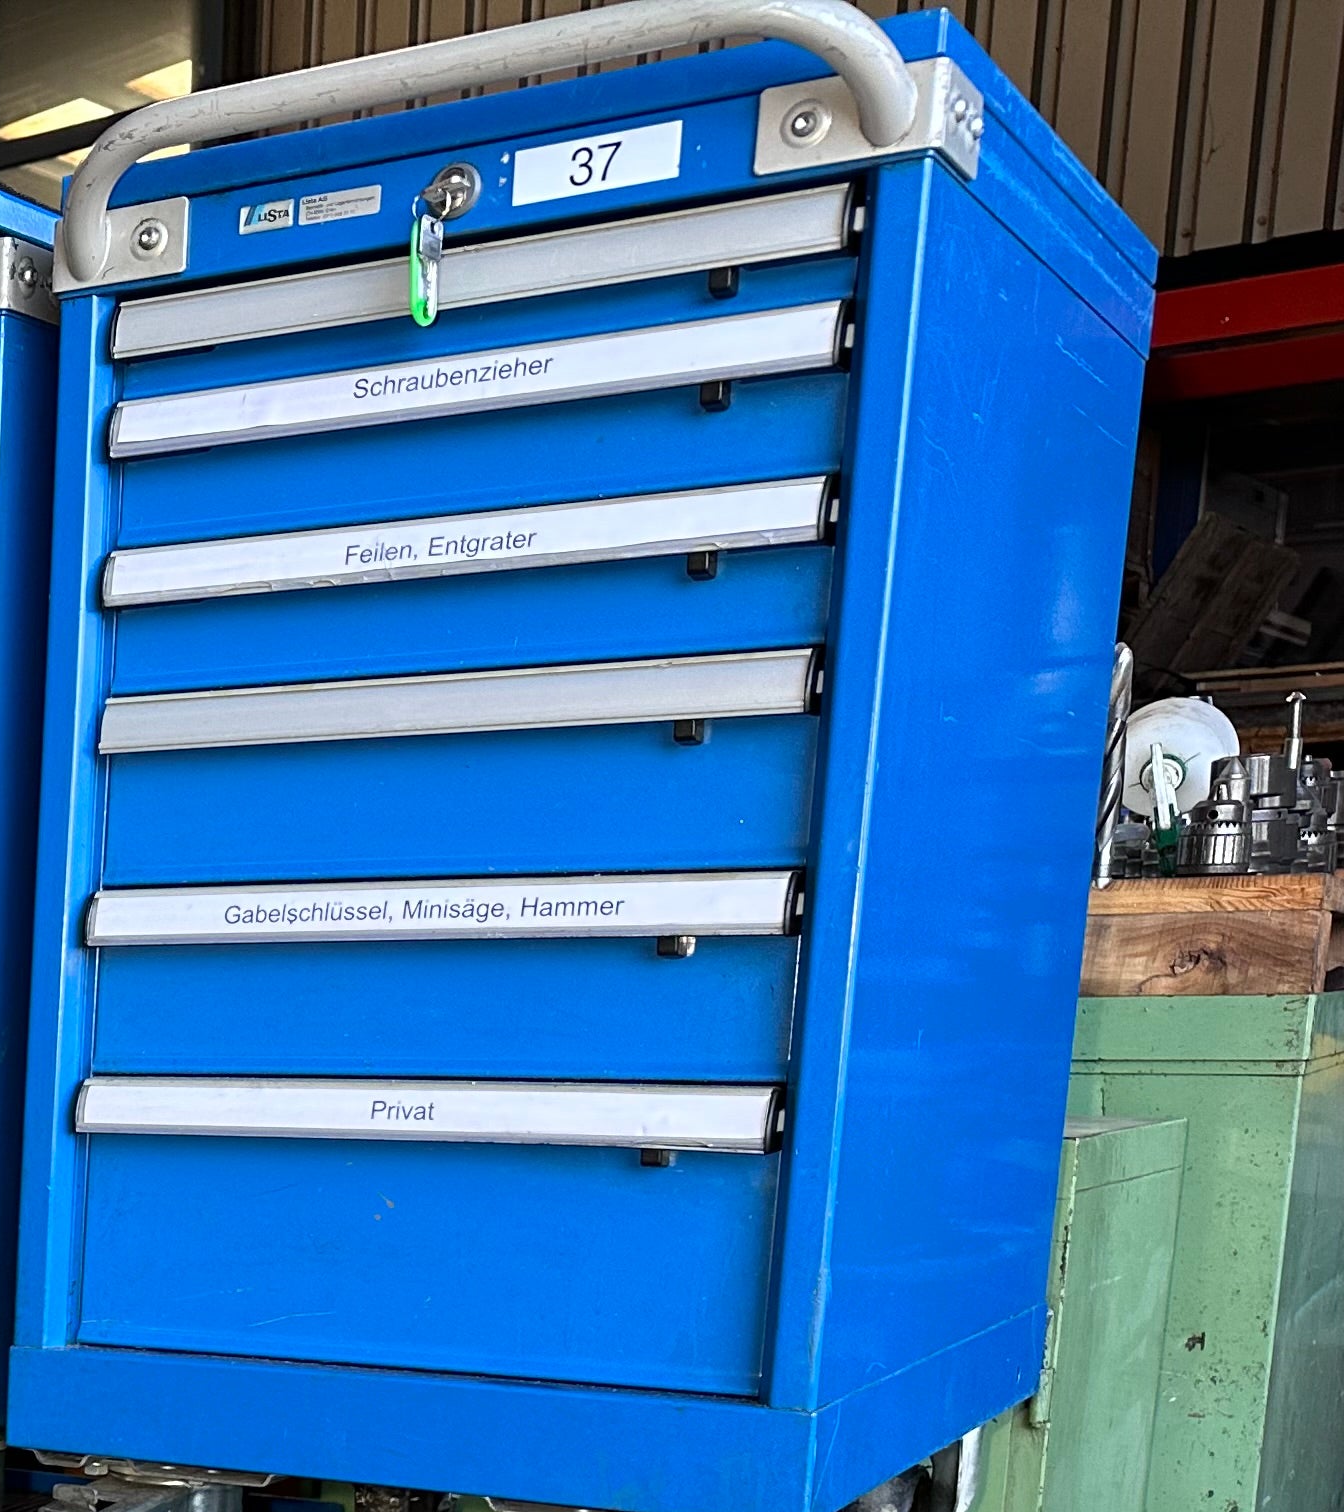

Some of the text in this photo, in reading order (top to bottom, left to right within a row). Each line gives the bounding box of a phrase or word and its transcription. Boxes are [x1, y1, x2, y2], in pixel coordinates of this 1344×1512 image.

[569, 141, 623, 186] 37
[258, 208, 290, 223] LISTA
[353, 357, 554, 399] Schraubenzieher
[345, 531, 538, 565] Feilen, Entgrater
[224, 897, 624, 924] Gabelschlüssel, Minisäge, Hammer
[370, 1100, 434, 1121] Privat
